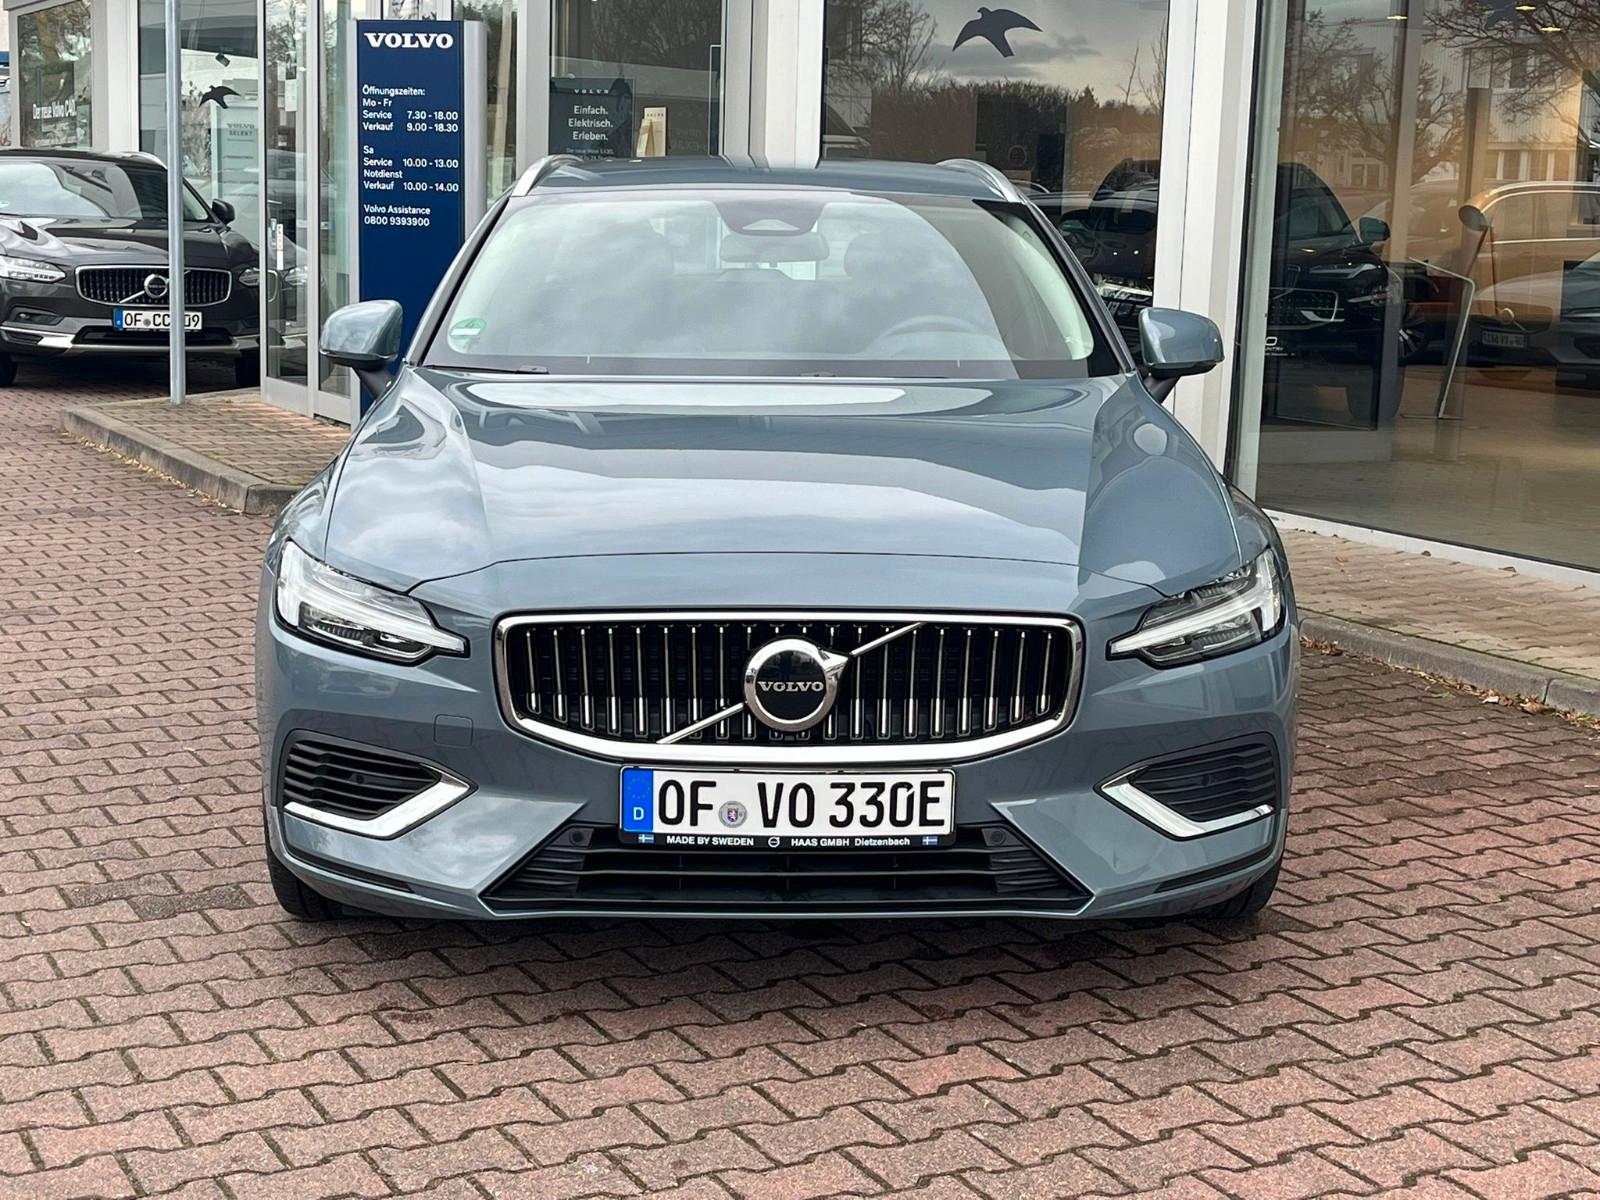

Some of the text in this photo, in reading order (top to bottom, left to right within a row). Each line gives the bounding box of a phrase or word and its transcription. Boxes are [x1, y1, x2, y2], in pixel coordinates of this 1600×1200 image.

[364, 32, 454, 49] VOLVO
[362, 84, 426, 97] Öffnungszeiten:
[362, 98, 377, 107] Mo
[383, 98, 393, 107] Fr
[362, 109, 393, 119] Service
[407, 110, 427, 120] 7.30
[433, 111, 459, 121] 18.00
[573, 105, 608, 115] Einfach.
[362, 121, 394, 131] Verkauf
[406, 122, 427, 132] 9.00
[434, 123, 459, 133] 18.30
[568, 118, 613, 128] Elektrisch.
[572, 131, 608, 141] Erleben.
[363, 145, 374, 154] Sa
[363, 157, 393, 167] Service
[402, 158, 427, 168] 10.00
[434, 159, 459, 168] 13.00
[363, 169, 403, 179] Notdienst
[363, 180, 395, 190] Verkauf
[403, 181, 428, 191] 10.00
[434, 182, 459, 192] 14.00
[363, 204, 431, 215] Volvo Assistance
[364, 216, 430, 227] 0800 9393900
[124, 312, 143, 326] OF
[757, 681, 824, 692] VOLVO
[632, 779, 945, 829] D OF VO 330E
[666, 835, 911, 847] MADE BY SWEDEN HAAS GMBH Dietzenbach
